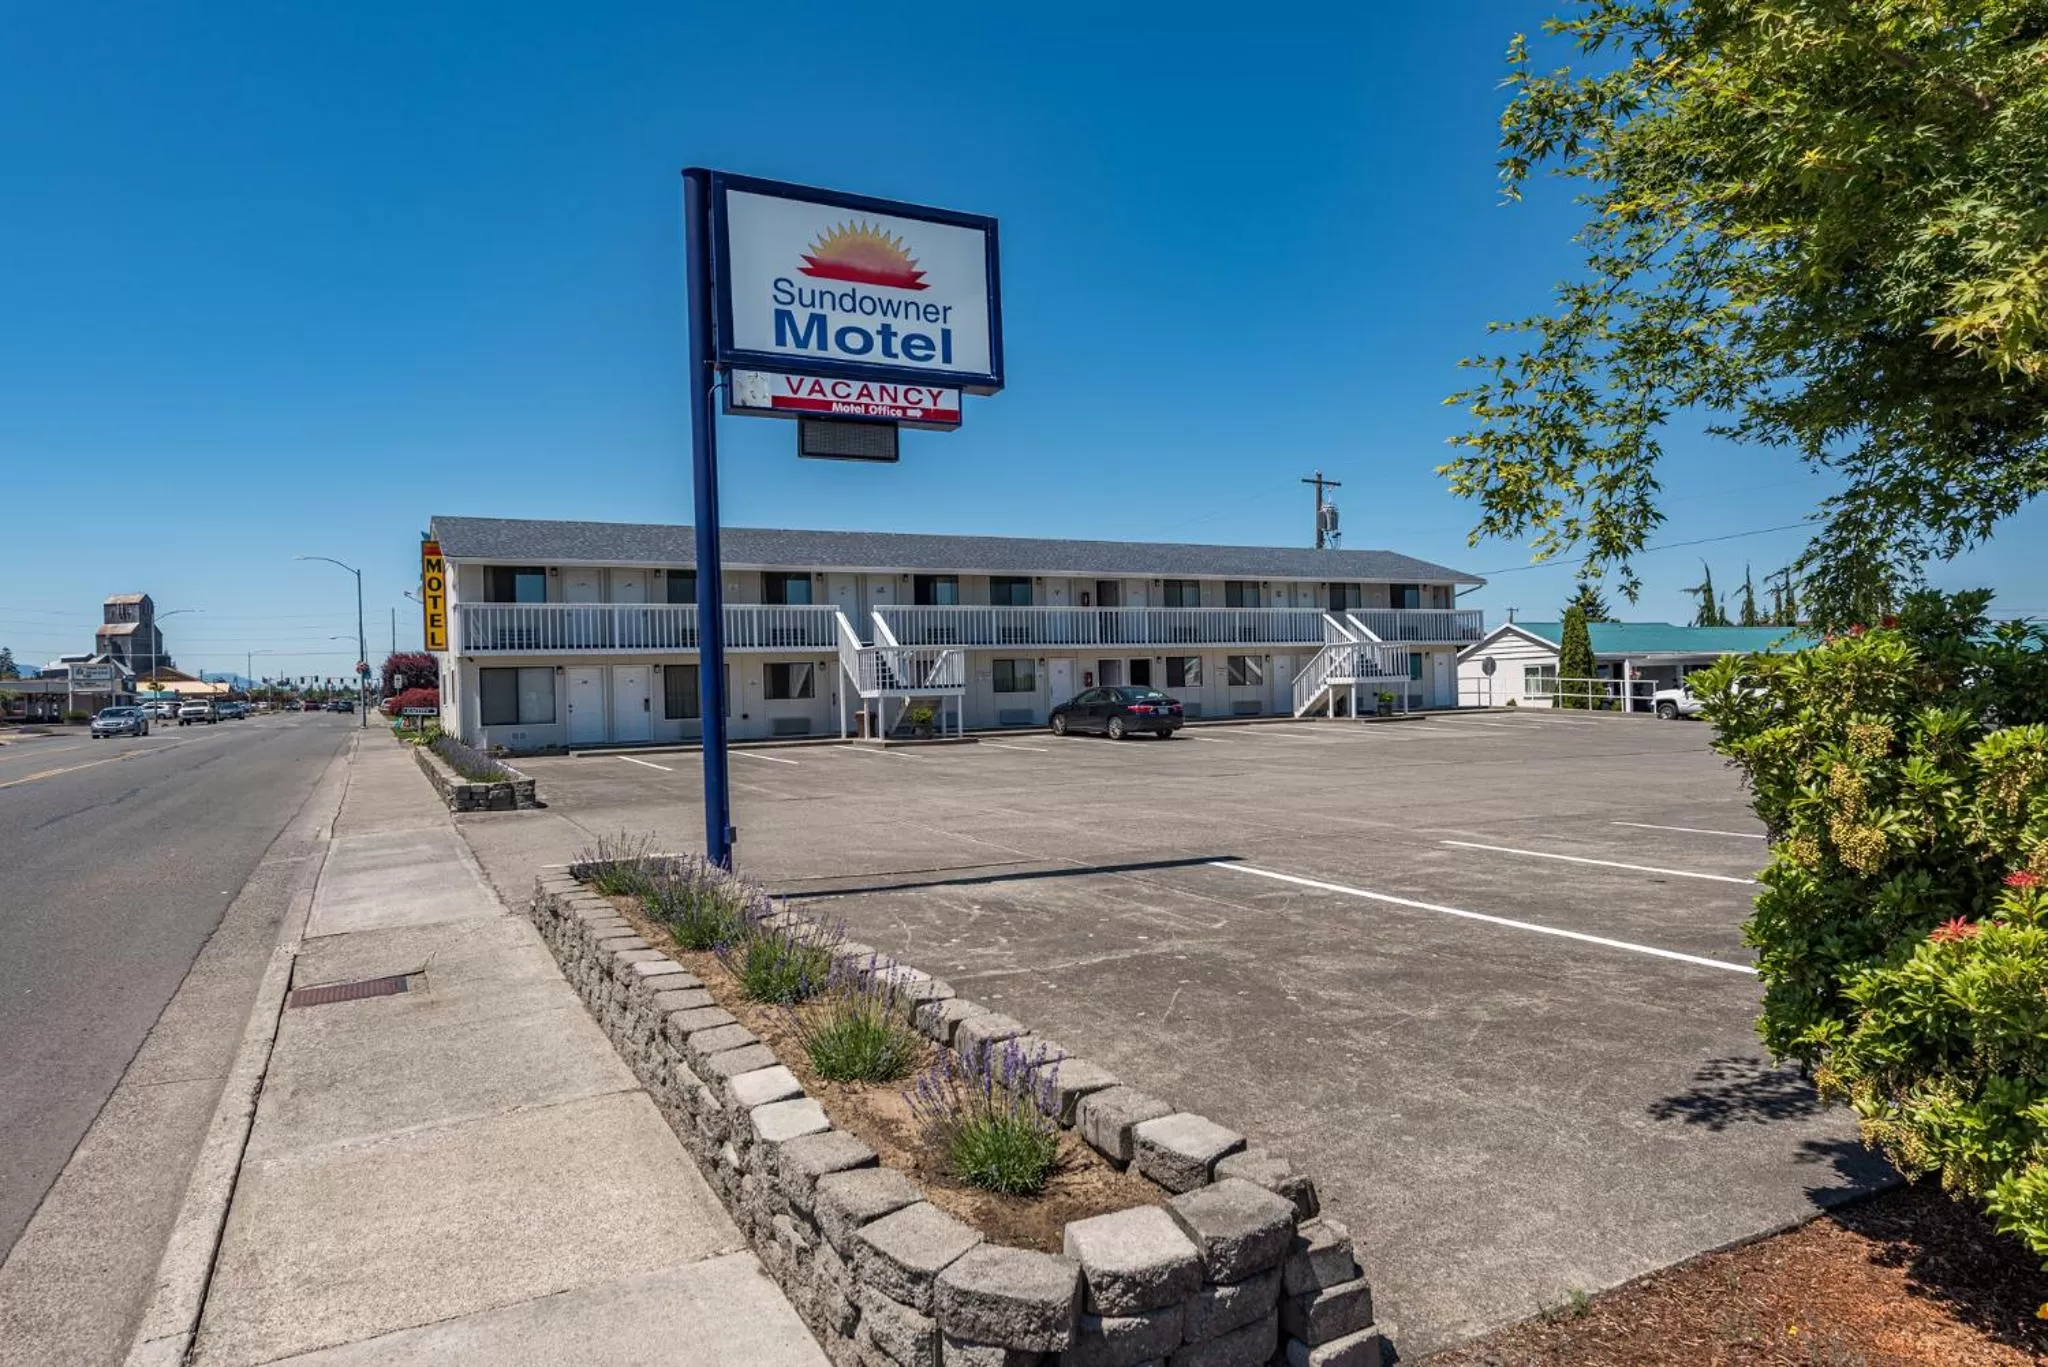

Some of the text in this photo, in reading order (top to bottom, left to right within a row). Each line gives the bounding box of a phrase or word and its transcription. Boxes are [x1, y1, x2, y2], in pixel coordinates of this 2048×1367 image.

[772, 278, 952, 324] Sundowner
[774, 308, 952, 364] Motel
[786, 376, 944, 407] VACANCY
[832, 402, 903, 417] Motel Office
[426, 558, 443, 646] MOTEL
